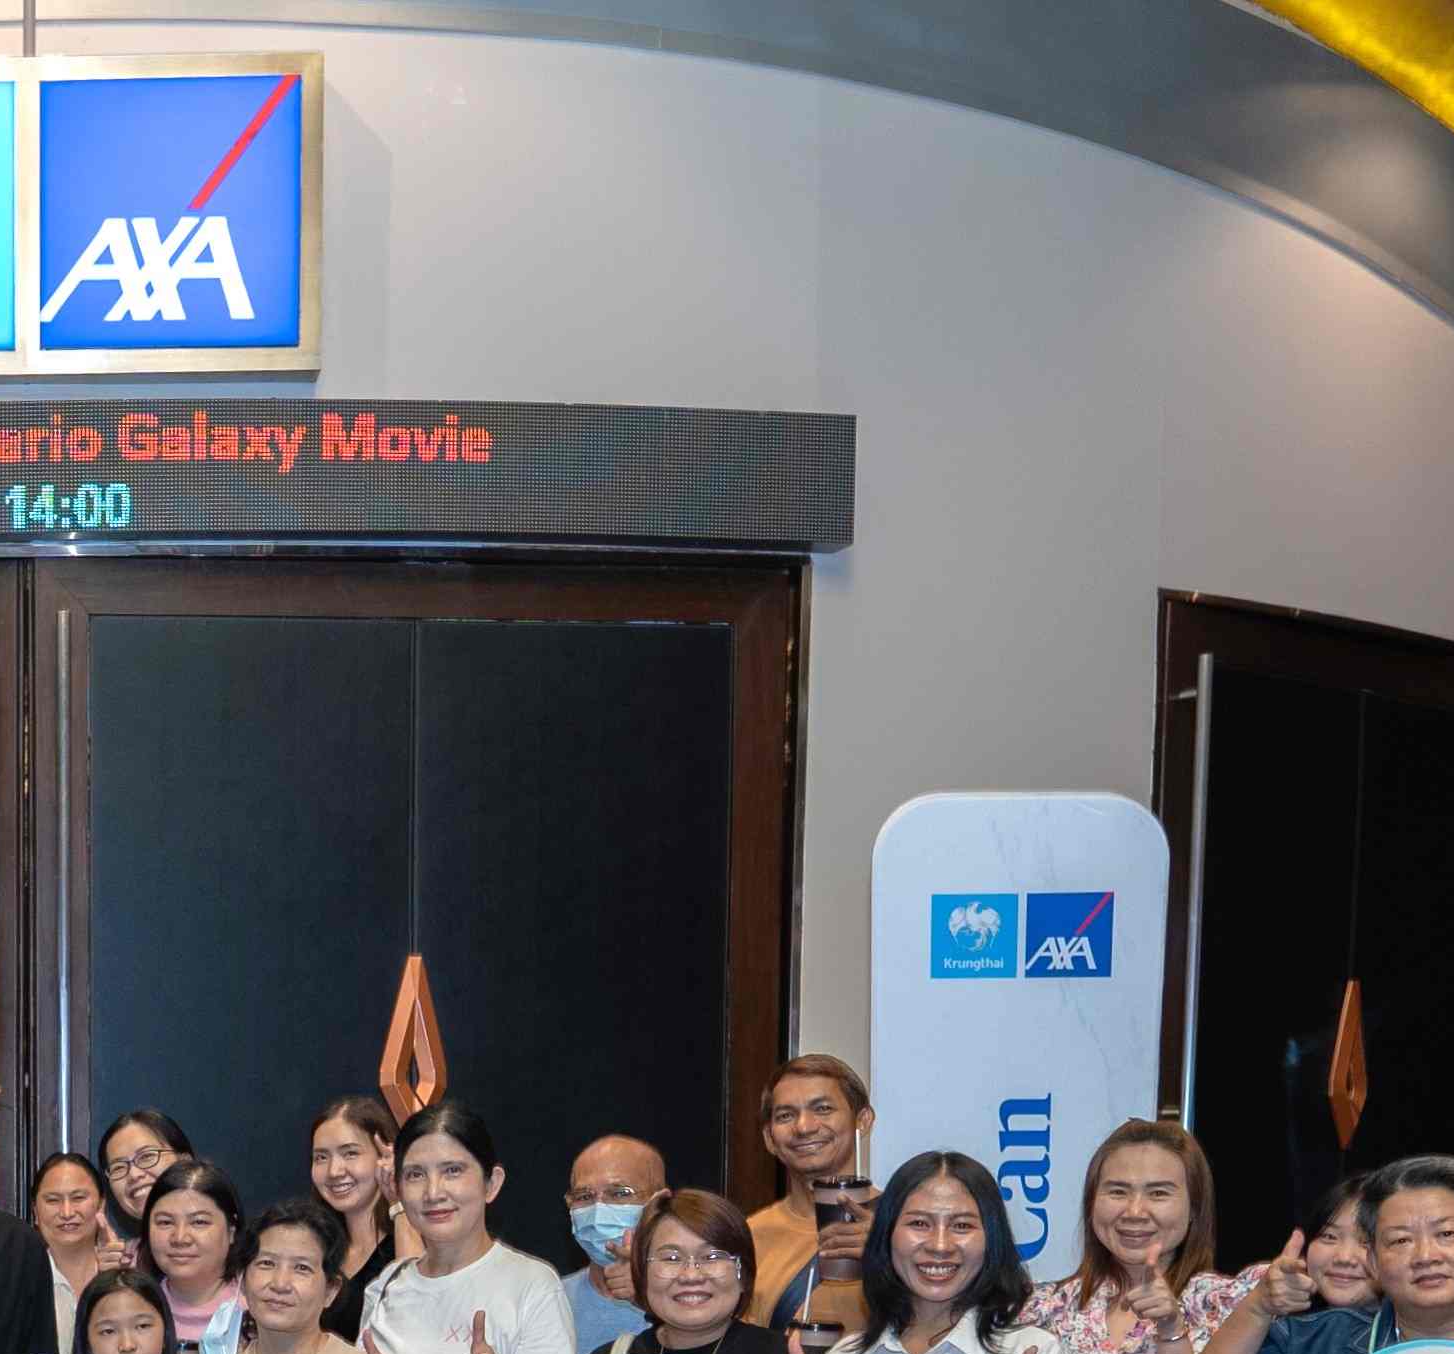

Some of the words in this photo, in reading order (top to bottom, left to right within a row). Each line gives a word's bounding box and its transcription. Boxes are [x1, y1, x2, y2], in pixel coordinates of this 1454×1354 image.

[40, 214, 255, 322] AXA
[116, 408, 308, 474] Galaxy
[320, 412, 492, 464] Movie
[5, 483, 132, 529] 14:00
[943, 957, 1005, 972] Krungthai
[1026, 936, 1097, 971] AXA
